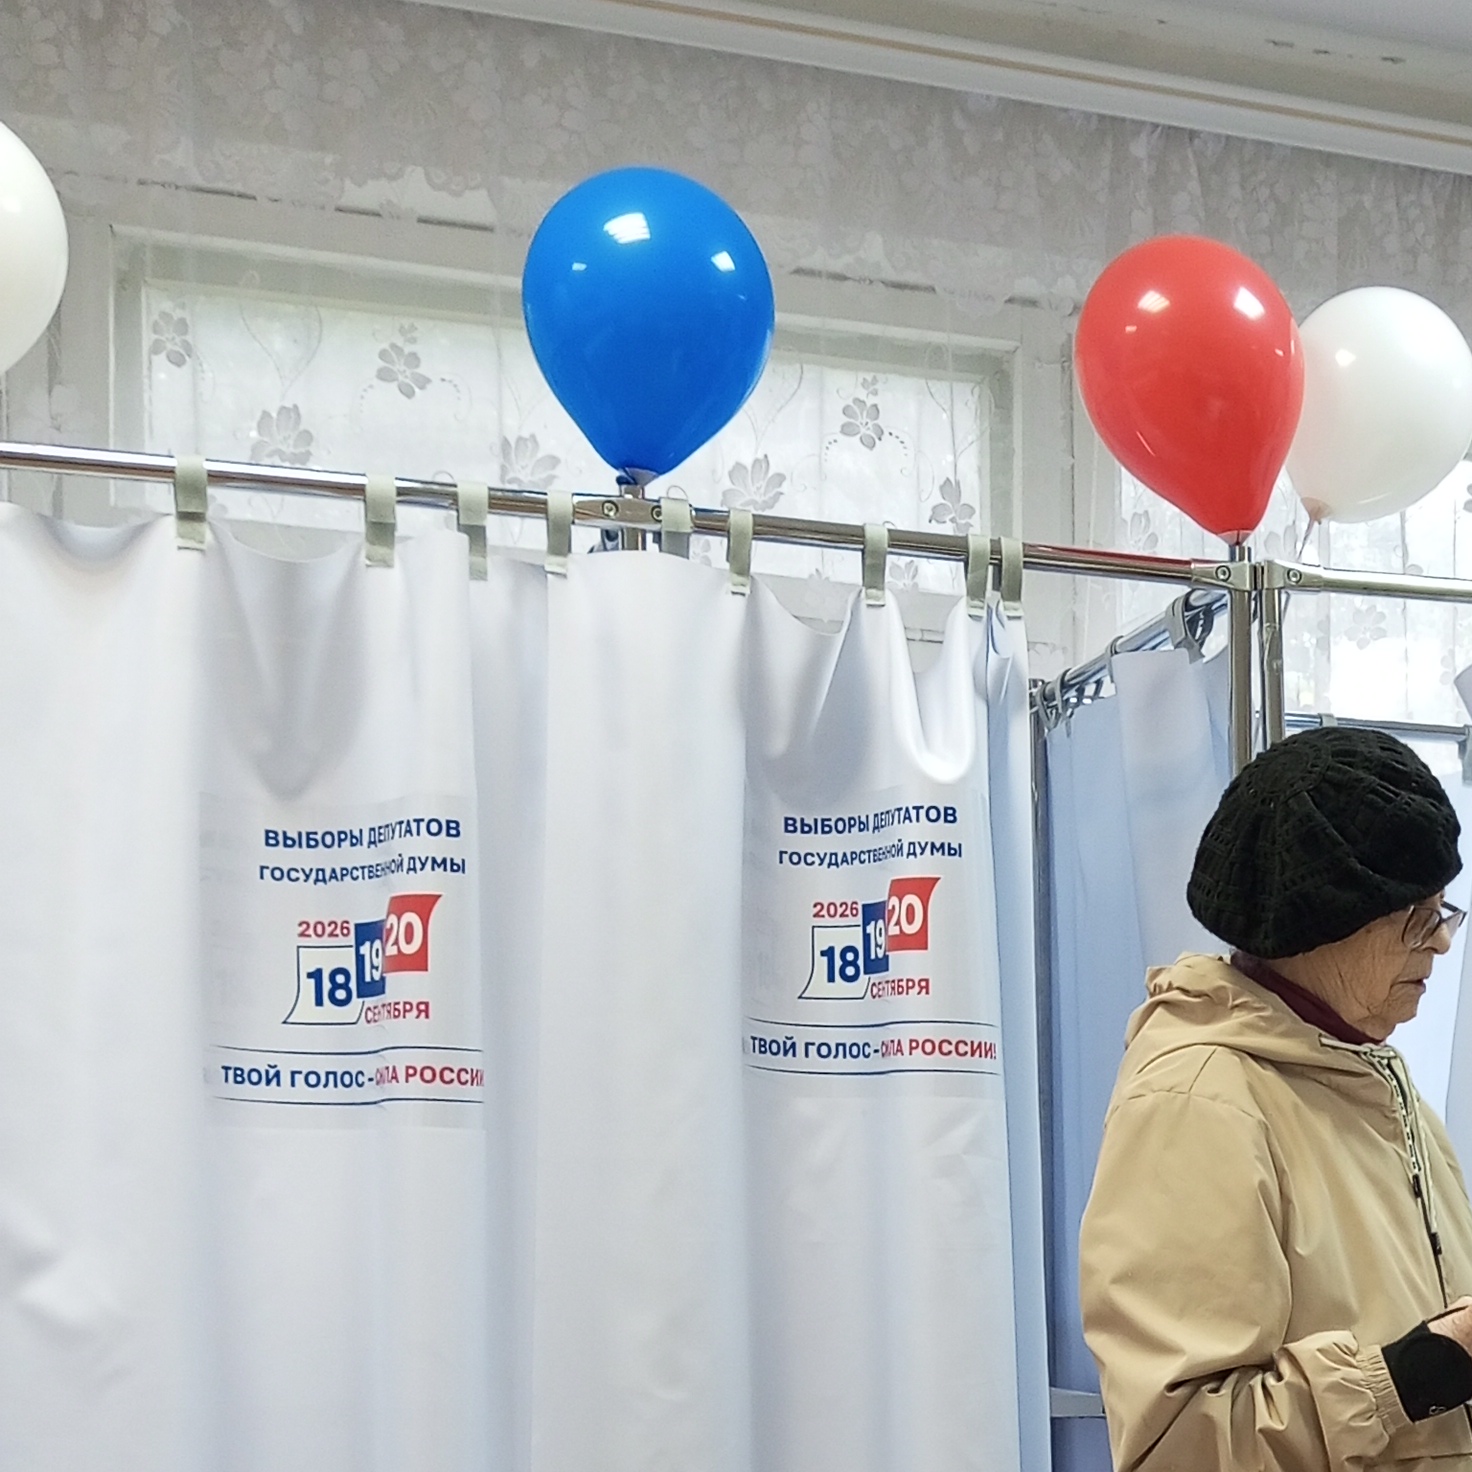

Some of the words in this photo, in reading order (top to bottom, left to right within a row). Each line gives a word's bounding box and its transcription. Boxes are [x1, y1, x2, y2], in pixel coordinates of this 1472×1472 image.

[264, 828, 363, 849] ВЫБОРЫ
[367, 818, 461, 849] ДЕПУТАТОВ
[784, 815, 869, 835] ВЫБОРЫ
[872, 805, 957, 834] ДЕПУТАТОВ
[259, 853, 404, 885] ГОСУДАРСТВЕННОЙ
[406, 855, 466, 875] ДУМЫ
[779, 838, 904, 869] ГОСУДАРСТВЕННОЙ
[906, 841, 962, 860] ДУМЫ
[812, 901, 859, 918] 2026
[888, 893, 924, 936] 20
[297, 920, 350, 938] 2026
[385, 911, 423, 956] 20
[866, 919, 885, 960] 19
[359, 939, 383, 983] 19
[820, 945, 861, 983] 18
[306, 967, 353, 1007] 18
[870, 978, 930, 1000] СЕНТЯБРЯ
[750, 1035, 796, 1058] ТВОЙ
[908, 1038, 996, 1060] РОССИИ!
[221, 1064, 281, 1087] ТВОЙ
